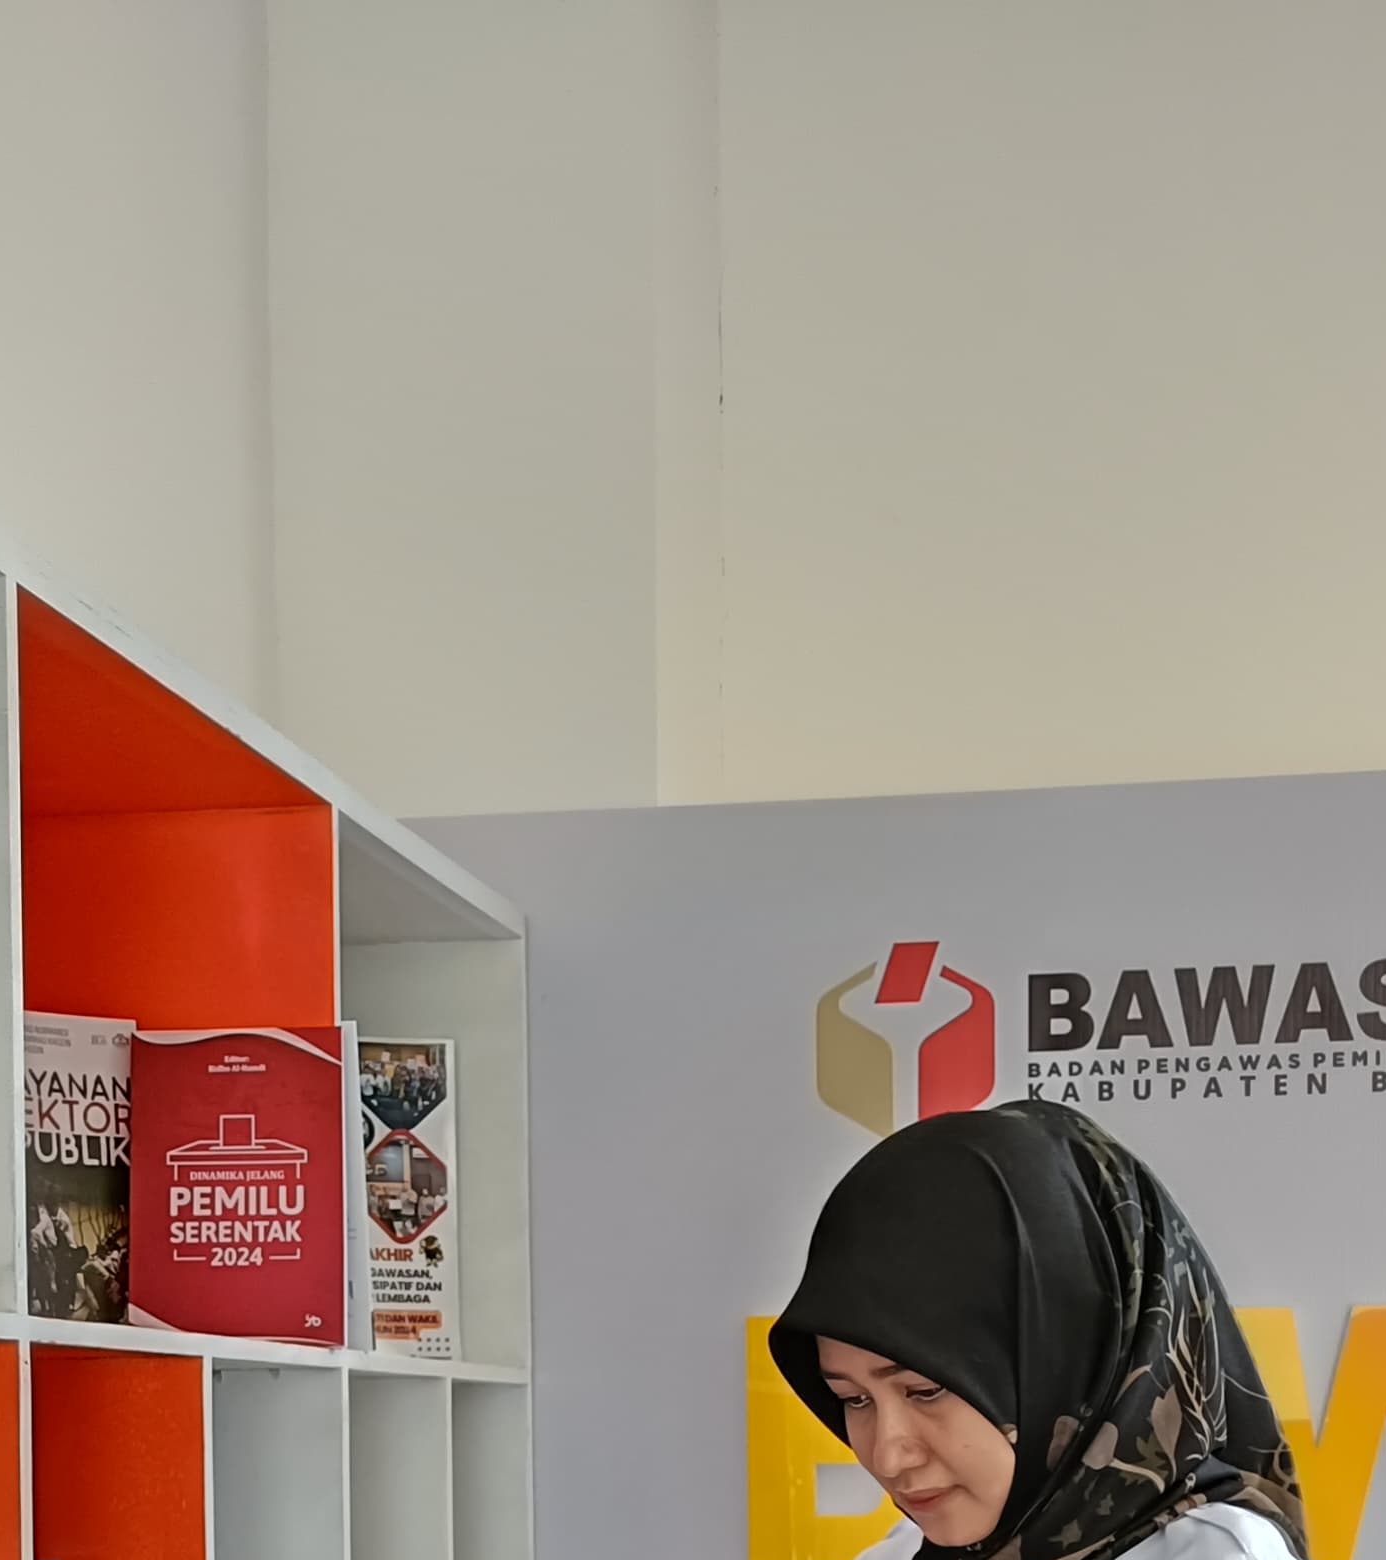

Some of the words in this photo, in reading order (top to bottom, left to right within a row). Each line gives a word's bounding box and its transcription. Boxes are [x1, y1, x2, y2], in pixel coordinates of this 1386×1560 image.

[1027, 1058, 1127, 1079] BADAN
[1136, 1052, 1303, 1075] PENGAWAS
[1027, 1070, 1330, 1103] KABUPATEN
[189, 1170, 245, 1182] DINAMIKA
[246, 1169, 286, 1182] JELANG
[169, 1184, 306, 1217] PEMILU
[169, 1219, 303, 1244] SERENTAK
[210, 1247, 264, 1267] 2024
[416, 1281, 442, 1292] DAN
[376, 1293, 432, 1304] LEMBAGA
